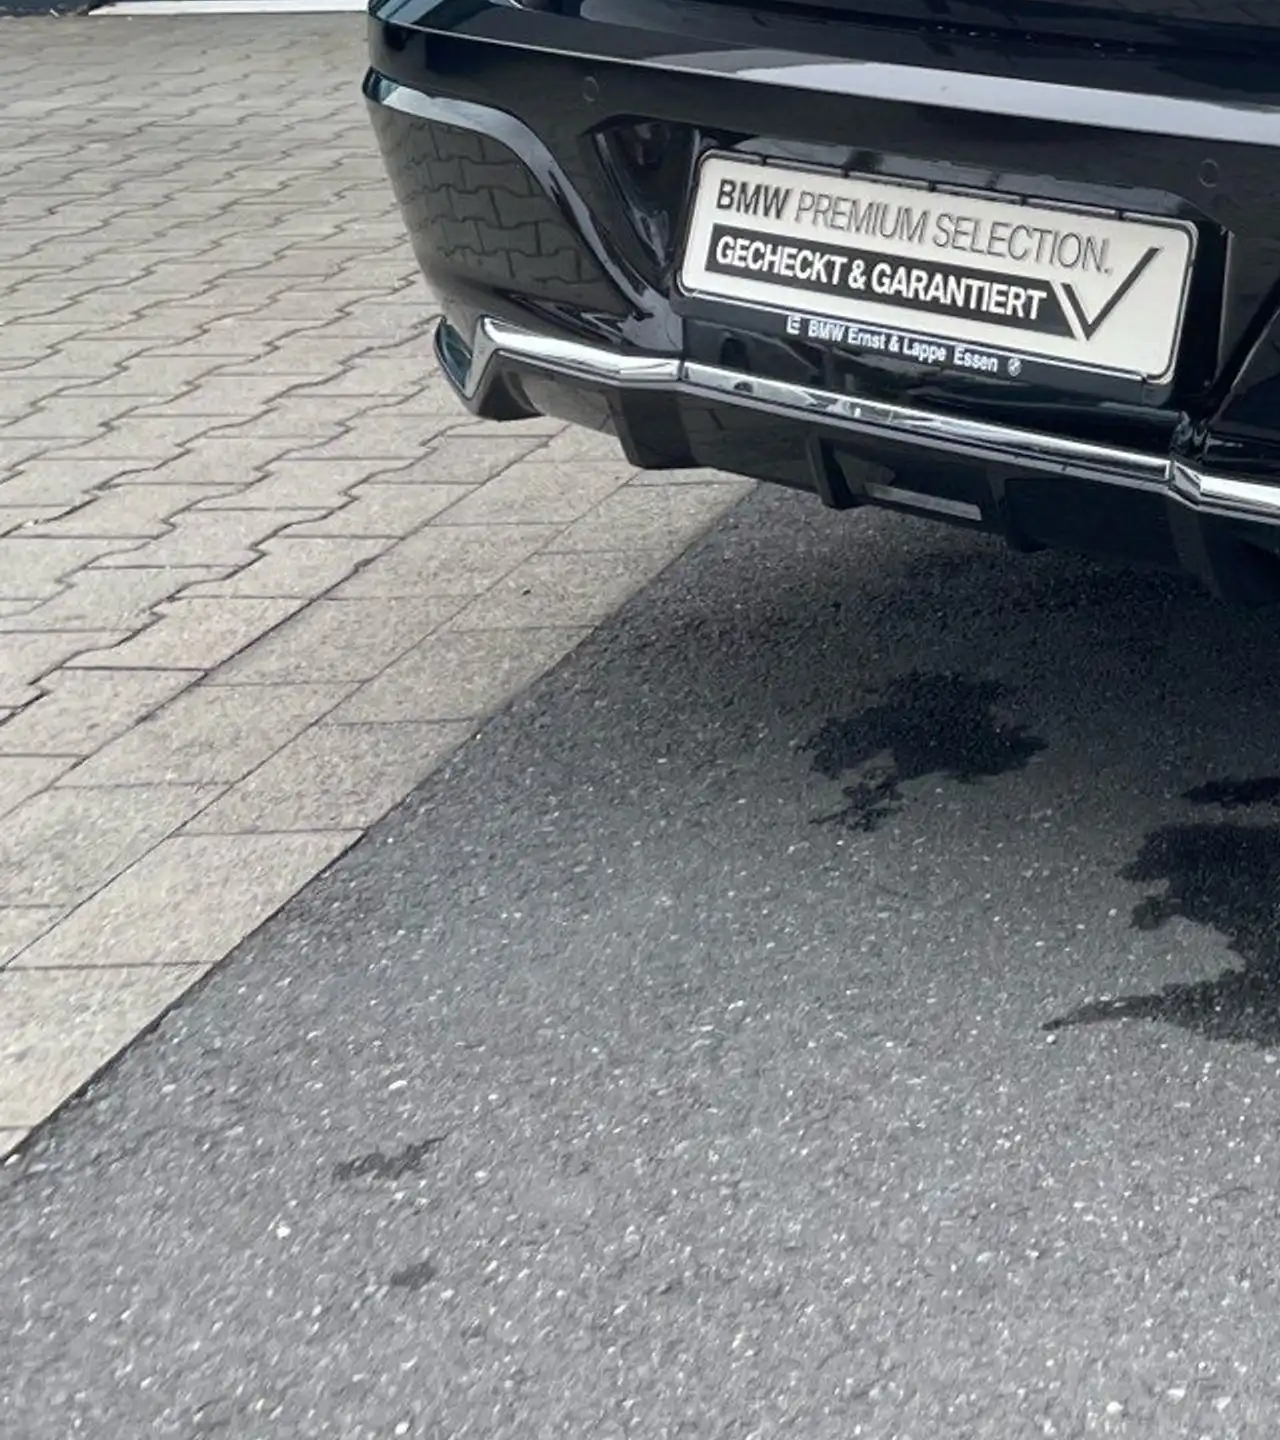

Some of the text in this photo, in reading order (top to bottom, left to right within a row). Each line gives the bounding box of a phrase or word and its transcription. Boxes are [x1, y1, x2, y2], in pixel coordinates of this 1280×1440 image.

[715, 178, 1112, 275] BMW PREMIUM SELECTION.
[715, 235, 1047, 320] GECHECKT & GARANTIERT
[808, 320, 846, 343] BMW
[848, 329, 886, 350] Ernst
[888, 336, 900, 353] &
[903, 338, 948, 363] Lappe
[953, 344, 999, 373] Essen
